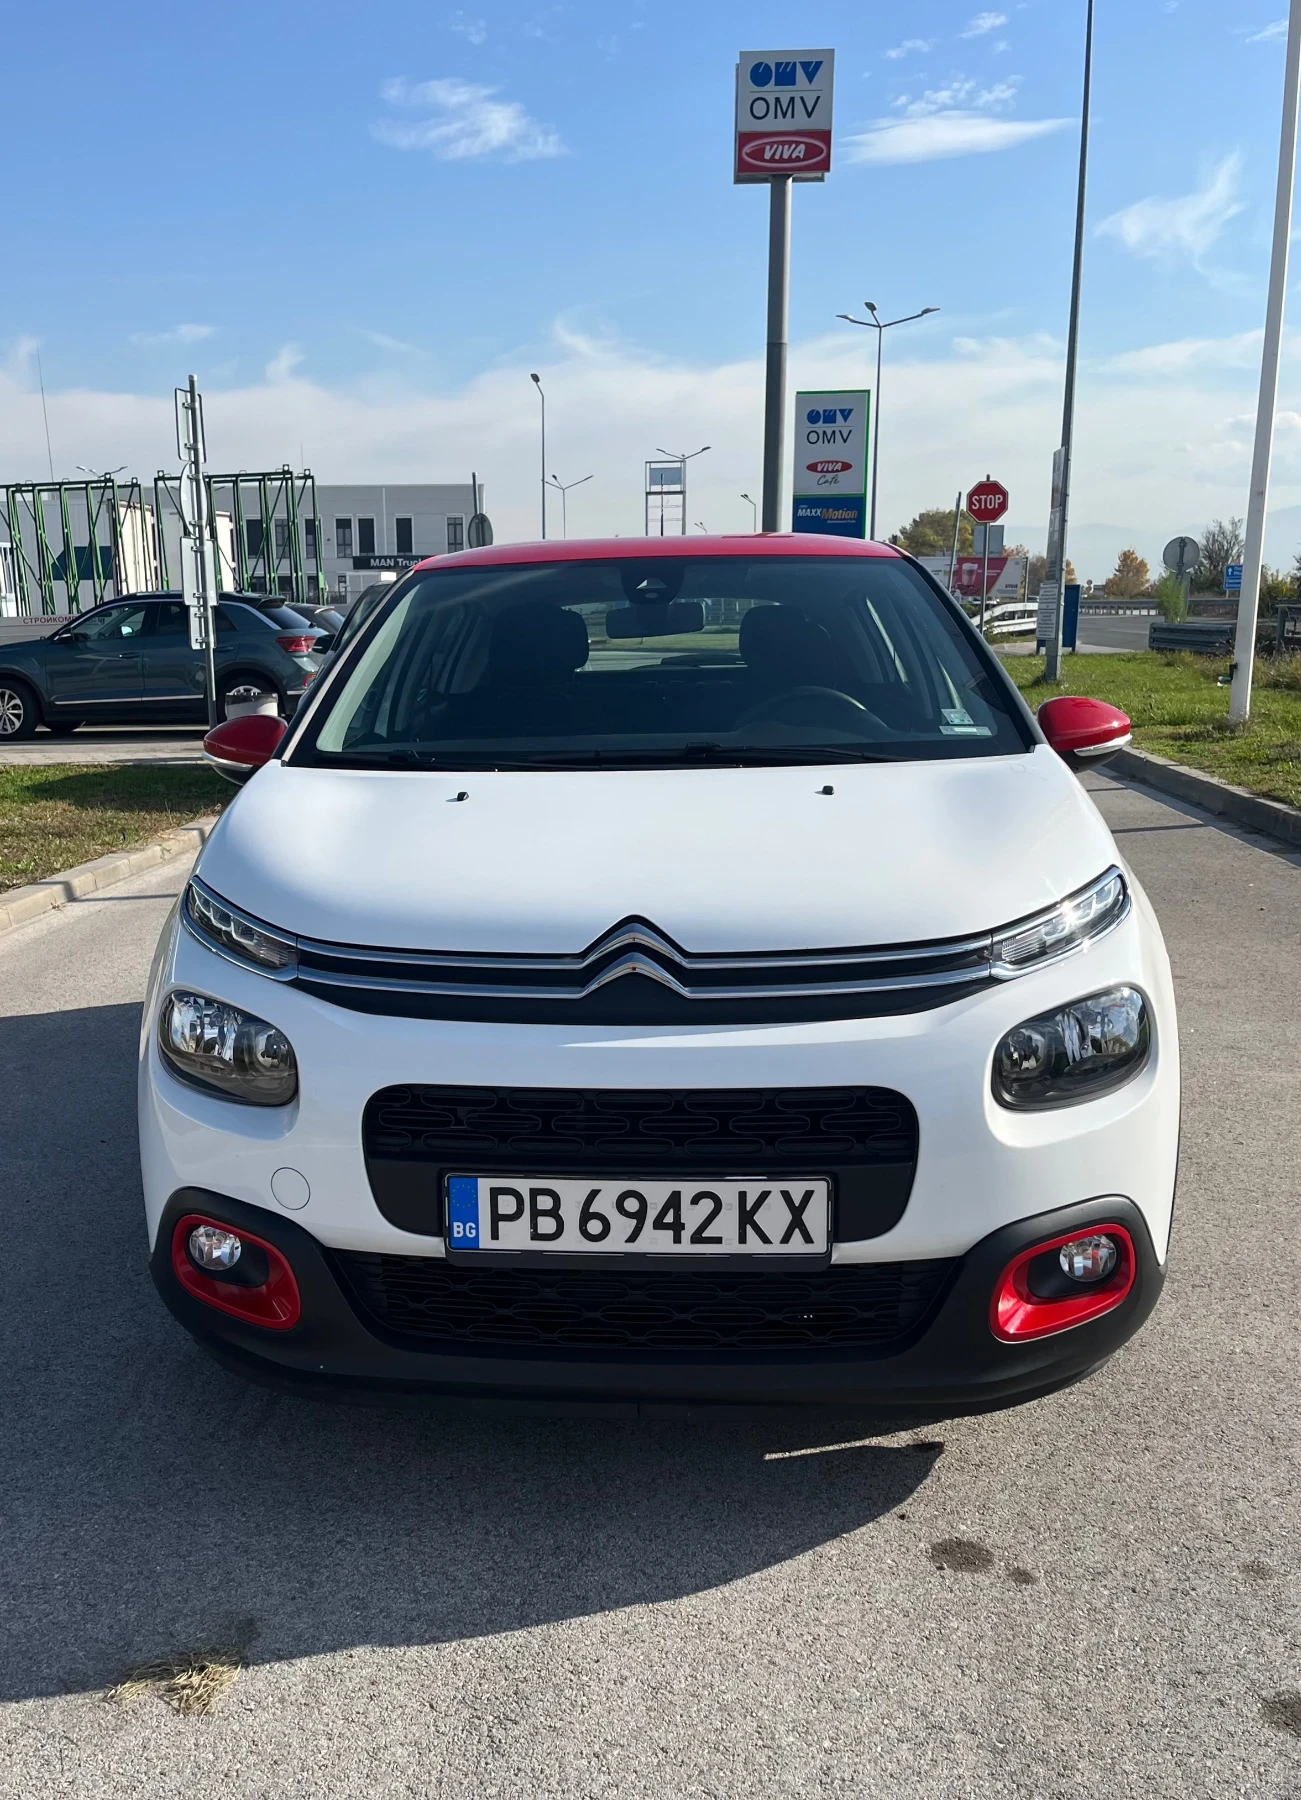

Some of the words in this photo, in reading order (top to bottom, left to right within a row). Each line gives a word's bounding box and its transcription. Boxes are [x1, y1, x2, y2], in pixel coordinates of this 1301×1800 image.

[750, 95, 821, 120] OMV
[763, 143, 806, 160] VIVA
[806, 429, 852, 445] OMV
[816, 462, 842, 471] VIVA
[971, 494, 1004, 510] STOP
[370, 558, 395, 567] MAN
[452, 1221, 477, 1238] BG
[489, 1187, 565, 1242] PB
[578, 1188, 724, 1244] 6942
[737, 1189, 815, 1245] KX
